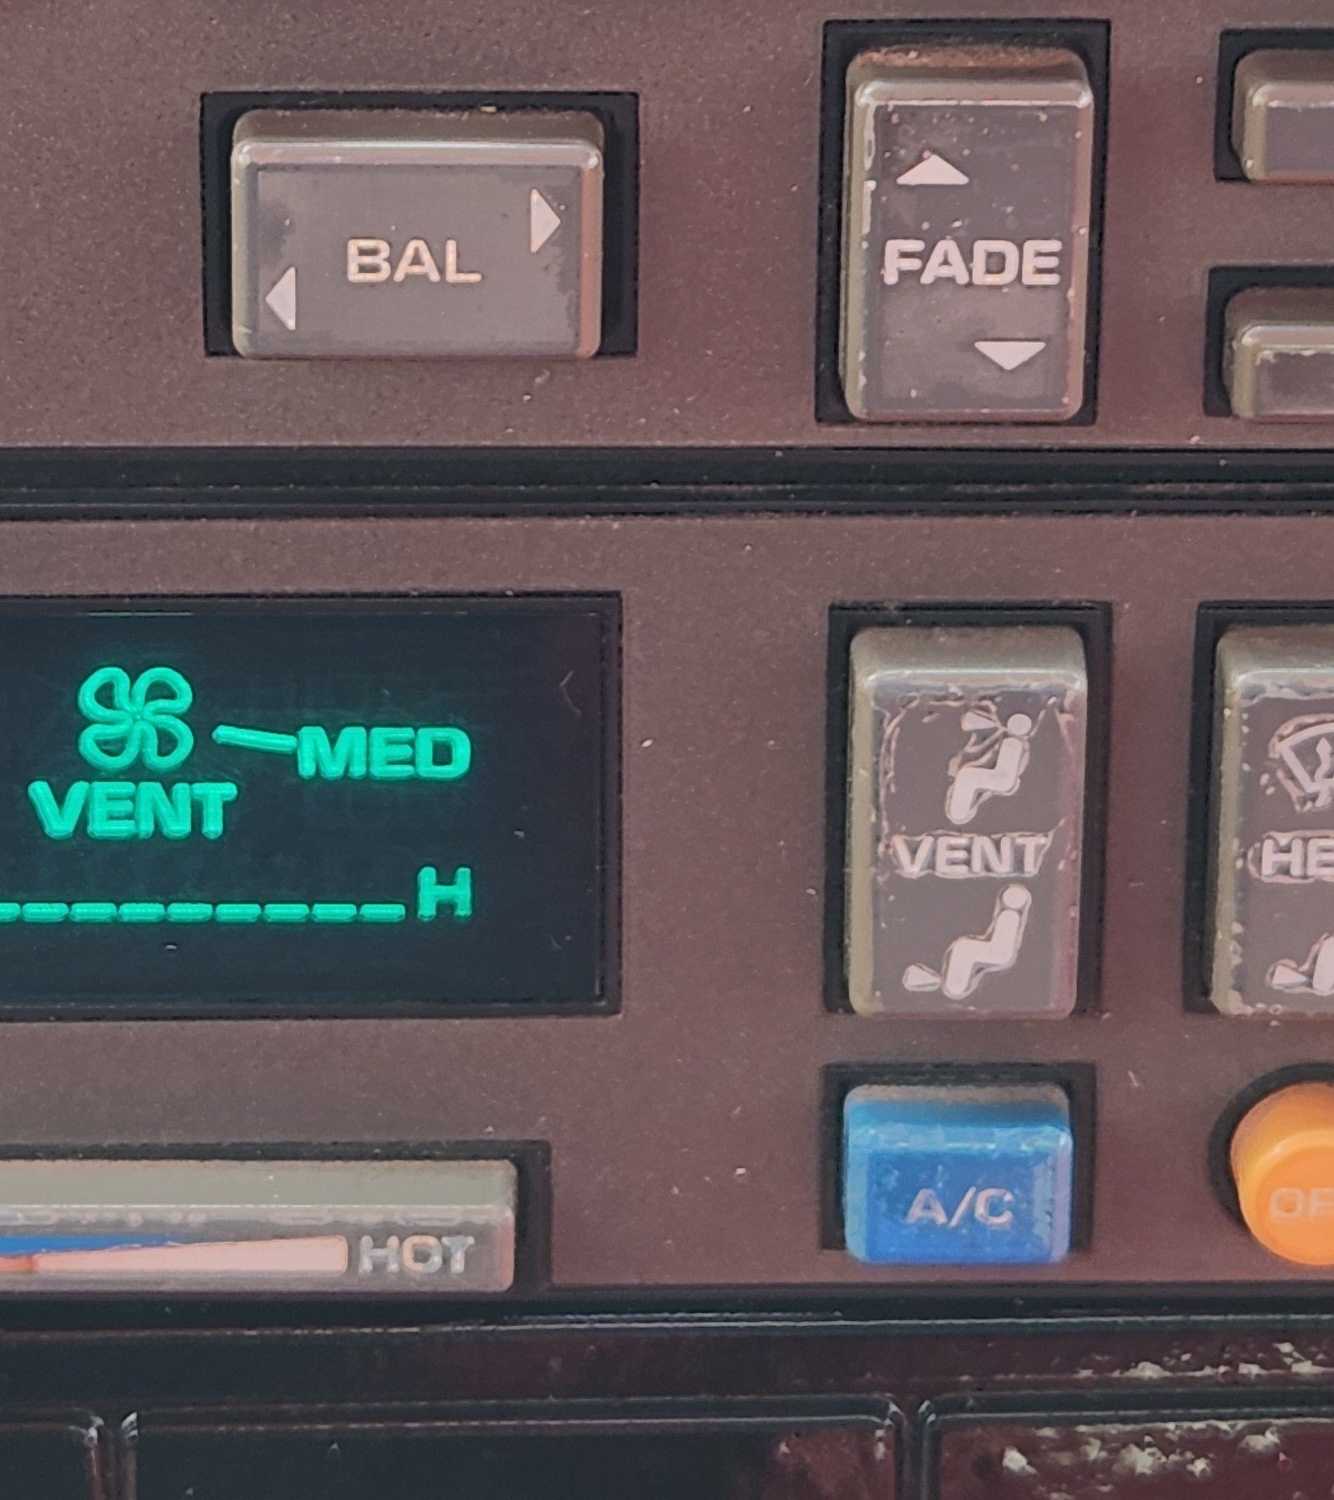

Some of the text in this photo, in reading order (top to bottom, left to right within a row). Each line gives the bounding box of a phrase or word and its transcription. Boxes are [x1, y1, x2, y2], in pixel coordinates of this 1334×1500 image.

[346, 237, 482, 284] BAL
[882, 239, 1063, 287] FADE
[297, 725, 473, 780] MED
[29, 780, 238, 840] VENT
[892, 836, 1047, 876] VENT
[417, 866, 473, 920] H
[907, 1184, 1013, 1229] A/C
[359, 1235, 475, 1276] HOT
